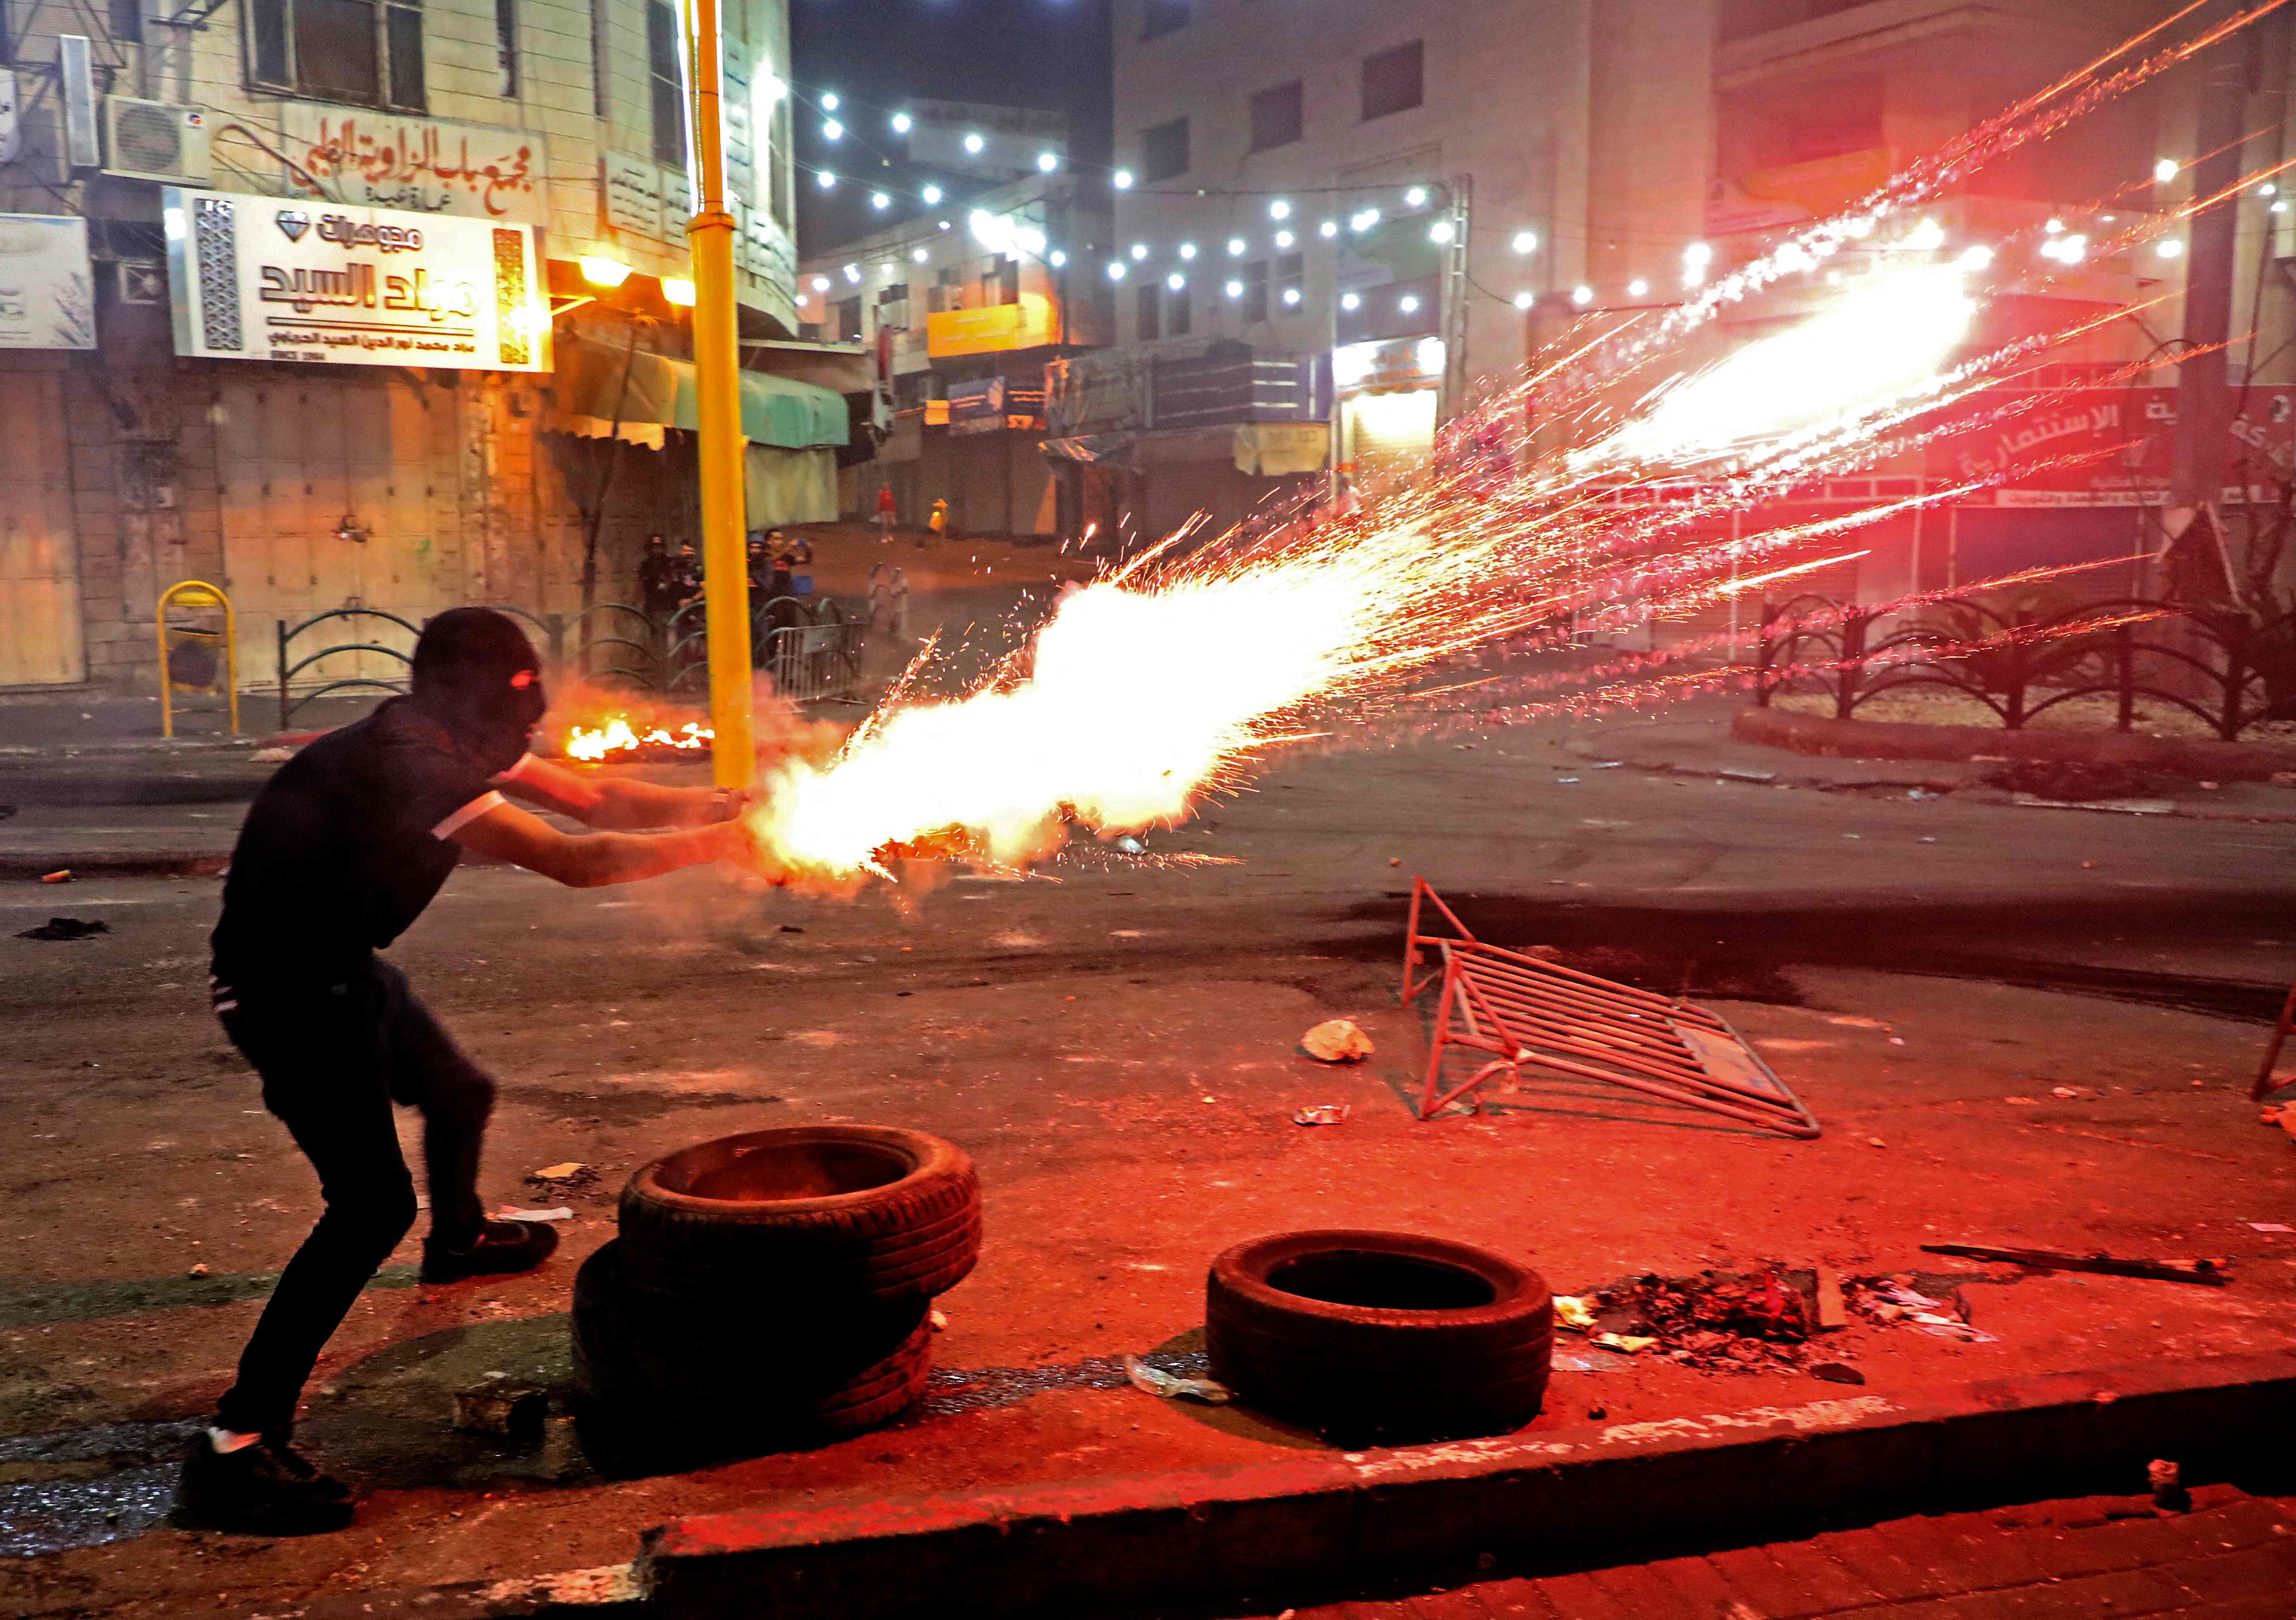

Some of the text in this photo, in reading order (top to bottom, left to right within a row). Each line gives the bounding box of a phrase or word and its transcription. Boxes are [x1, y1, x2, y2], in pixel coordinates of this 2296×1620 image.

[434, 135, 478, 192] باب
[316, 213, 425, 253] مجوهرات
[261, 263, 478, 321] مراد السيد
[323, 335, 359, 348] السيد
[415, 341, 449, 351] محمد
[452, 341, 475, 353] مراد
